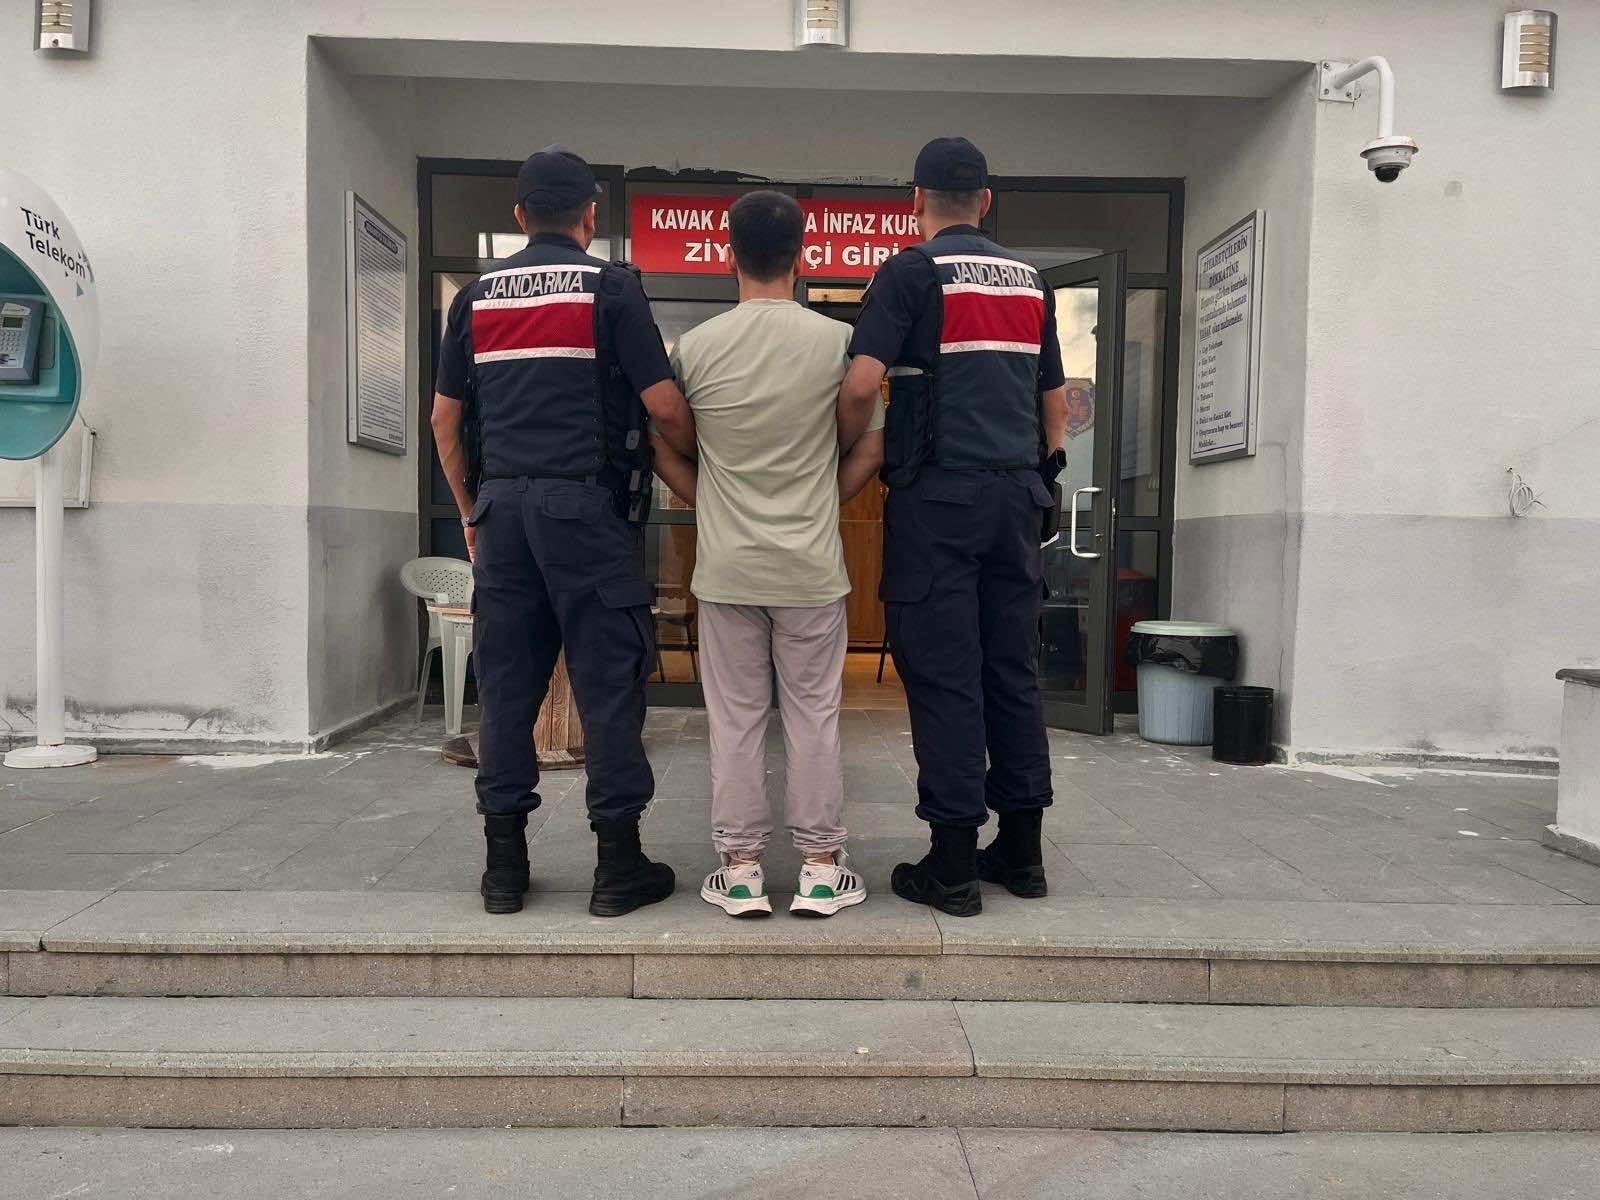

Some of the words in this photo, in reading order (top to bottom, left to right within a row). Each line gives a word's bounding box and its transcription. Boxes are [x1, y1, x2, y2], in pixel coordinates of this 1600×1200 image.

[20, 206, 60, 240] Türk
[651, 208, 714, 231] KAVAK
[824, 207, 876, 235] İNFAZ
[881, 213, 921, 236] KUR
[25, 230, 86, 279] Telekom
[684, 238, 832, 270] ZİYÇİ
[484, 270, 584, 299] JANDARMA
[952, 262, 1036, 289] JANDARMA
